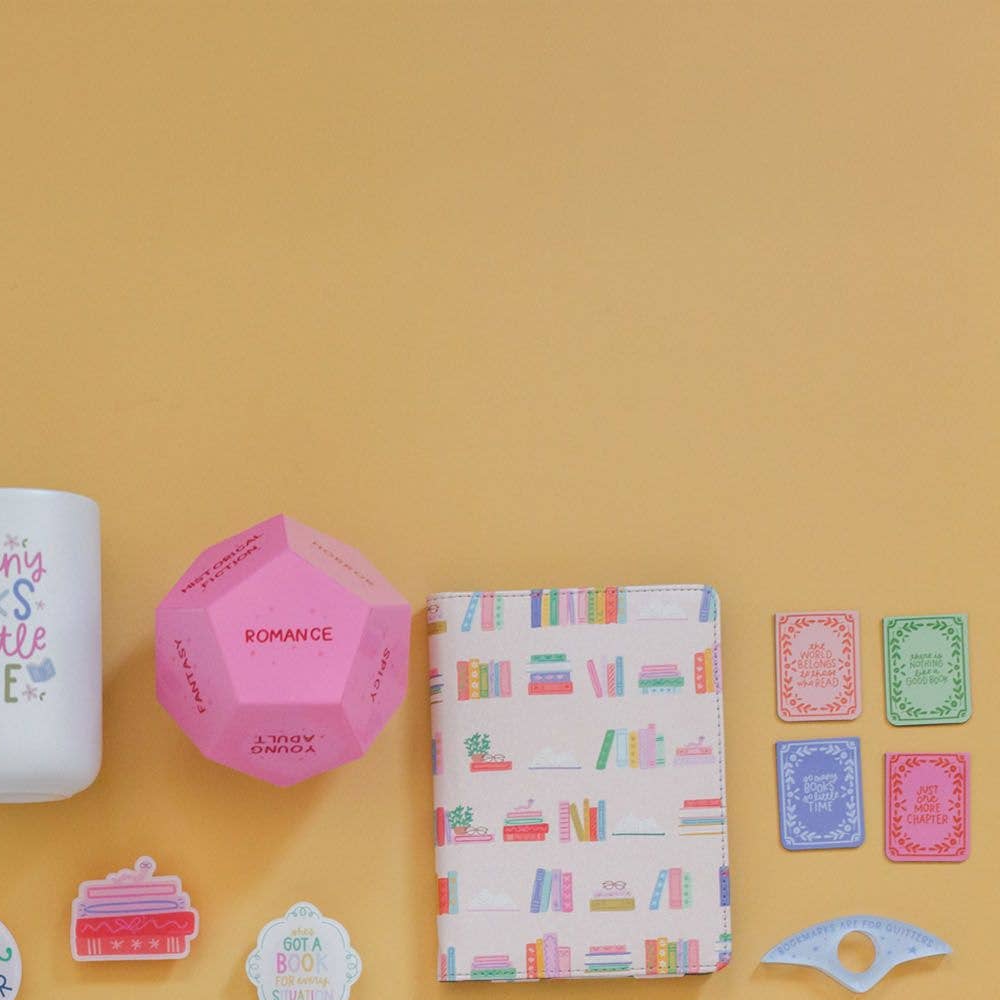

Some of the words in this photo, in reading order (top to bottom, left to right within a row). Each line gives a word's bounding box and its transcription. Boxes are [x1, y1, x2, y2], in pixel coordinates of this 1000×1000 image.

[200, 545, 261, 590] FICTION
[245, 627, 333, 643] ROMANCE
[800, 649, 832, 660] WORLD
[797, 659, 836, 669] BELONGS
[174, 639, 207, 715] FANTASY
[370, 647, 390, 702] SPICY
[254, 734, 315, 744] ADULT
[251, 745, 316, 754] YOUNG
[804, 781, 835, 794] BOOKS
[917, 785, 938, 795] JUST
[808, 801, 833, 813] TIME
[914, 803, 940, 813] MORE
[906, 814, 948, 825] CHAPTER
[777, 923, 837, 955] BOOKMARKS
[840, 919, 858, 930] ARE
[862, 920, 882, 929] FOR
[886, 924, 935, 948] QUITTERS
[283, 937, 309, 951] GOT
[312, 937, 322, 952] A
[276, 952, 329, 974] BOOK
[275, 976, 295, 987] FOR
